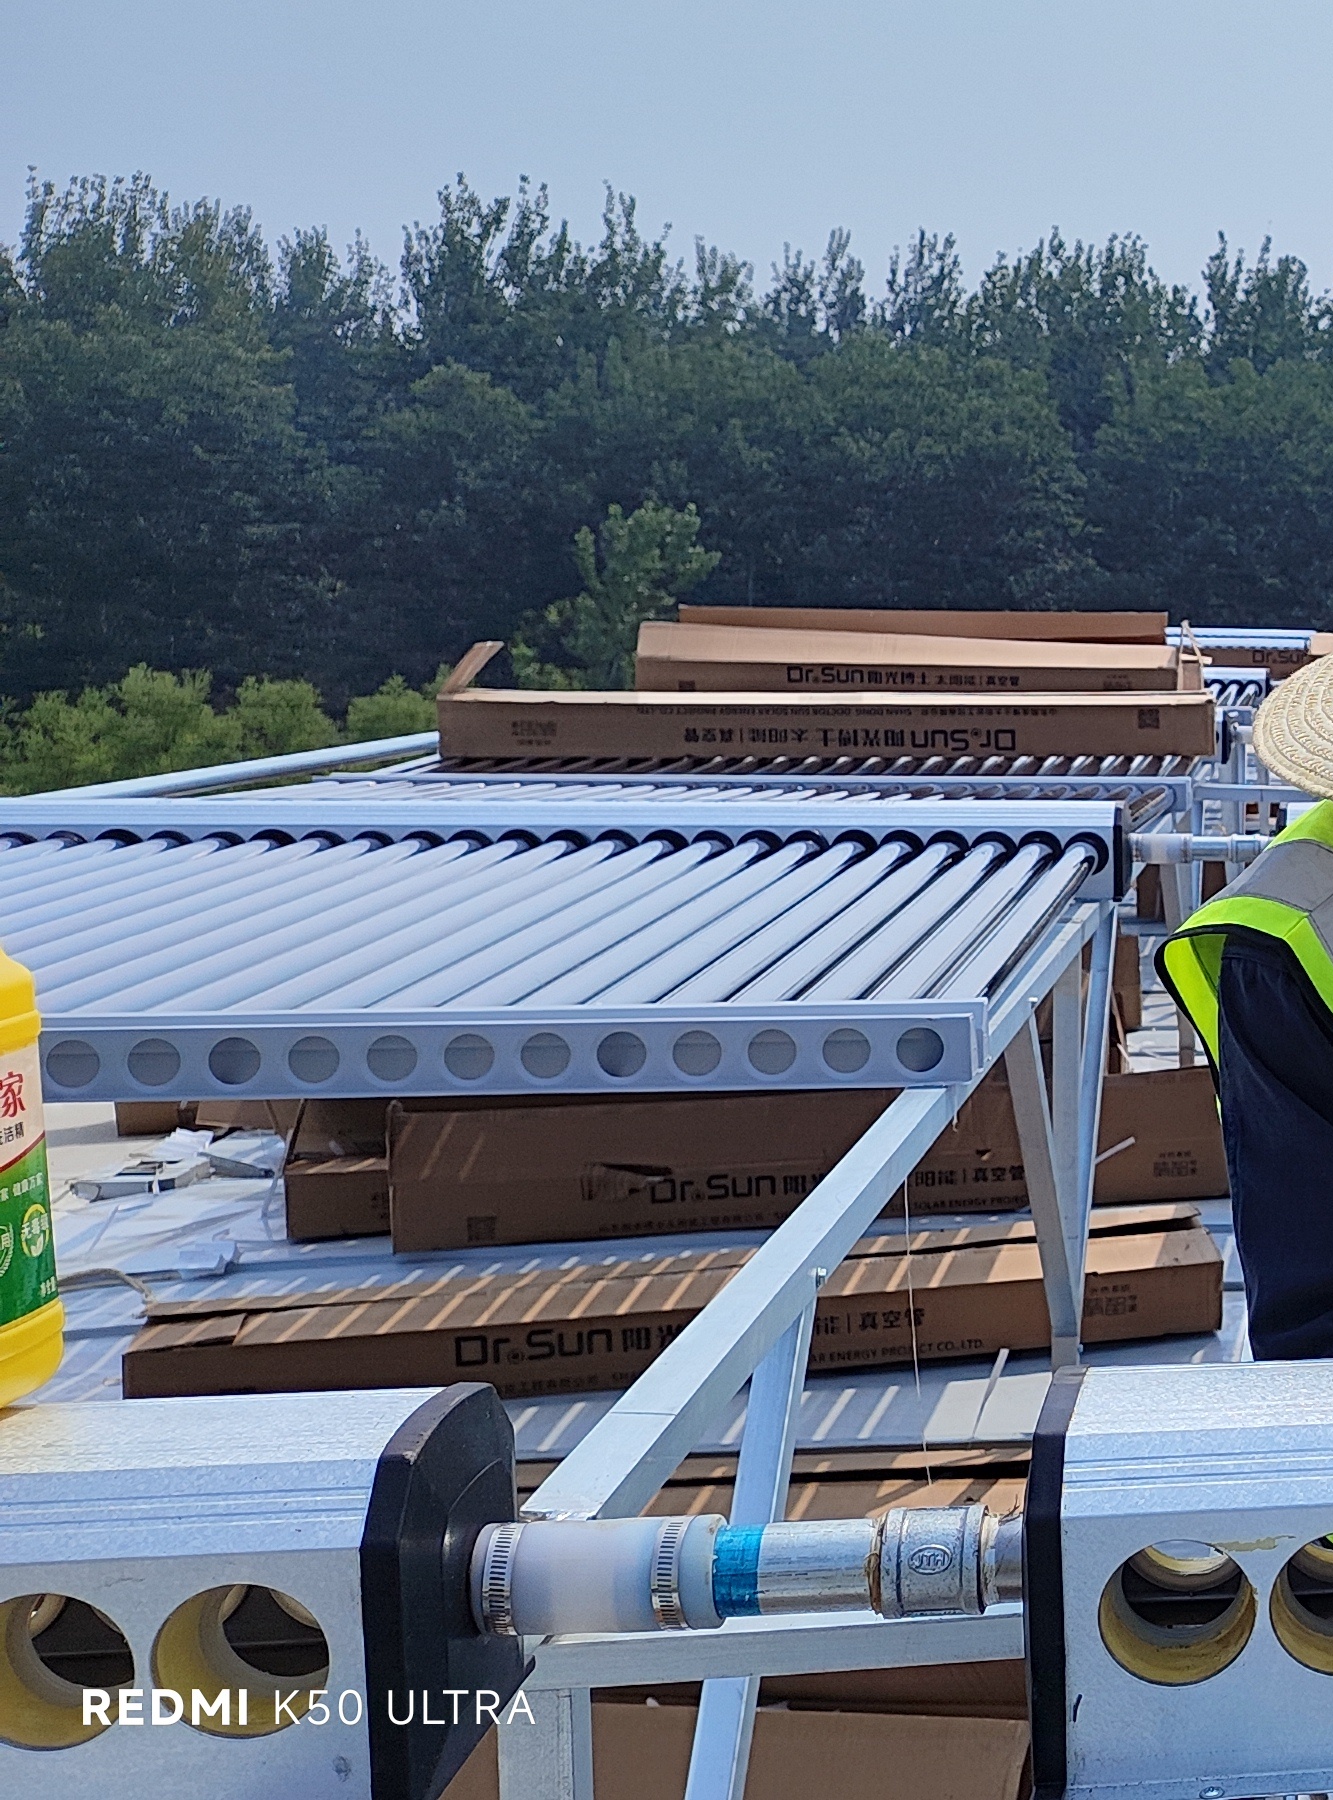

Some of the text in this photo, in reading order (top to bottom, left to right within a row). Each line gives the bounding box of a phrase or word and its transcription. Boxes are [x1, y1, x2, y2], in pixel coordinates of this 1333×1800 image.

[786, 665, 865, 684] Dr.Sun
[911, 727, 1017, 752] Dr.Sun
[651, 1173, 777, 1205] Dr.Sun
[455, 1327, 613, 1367] Dr.Sun
